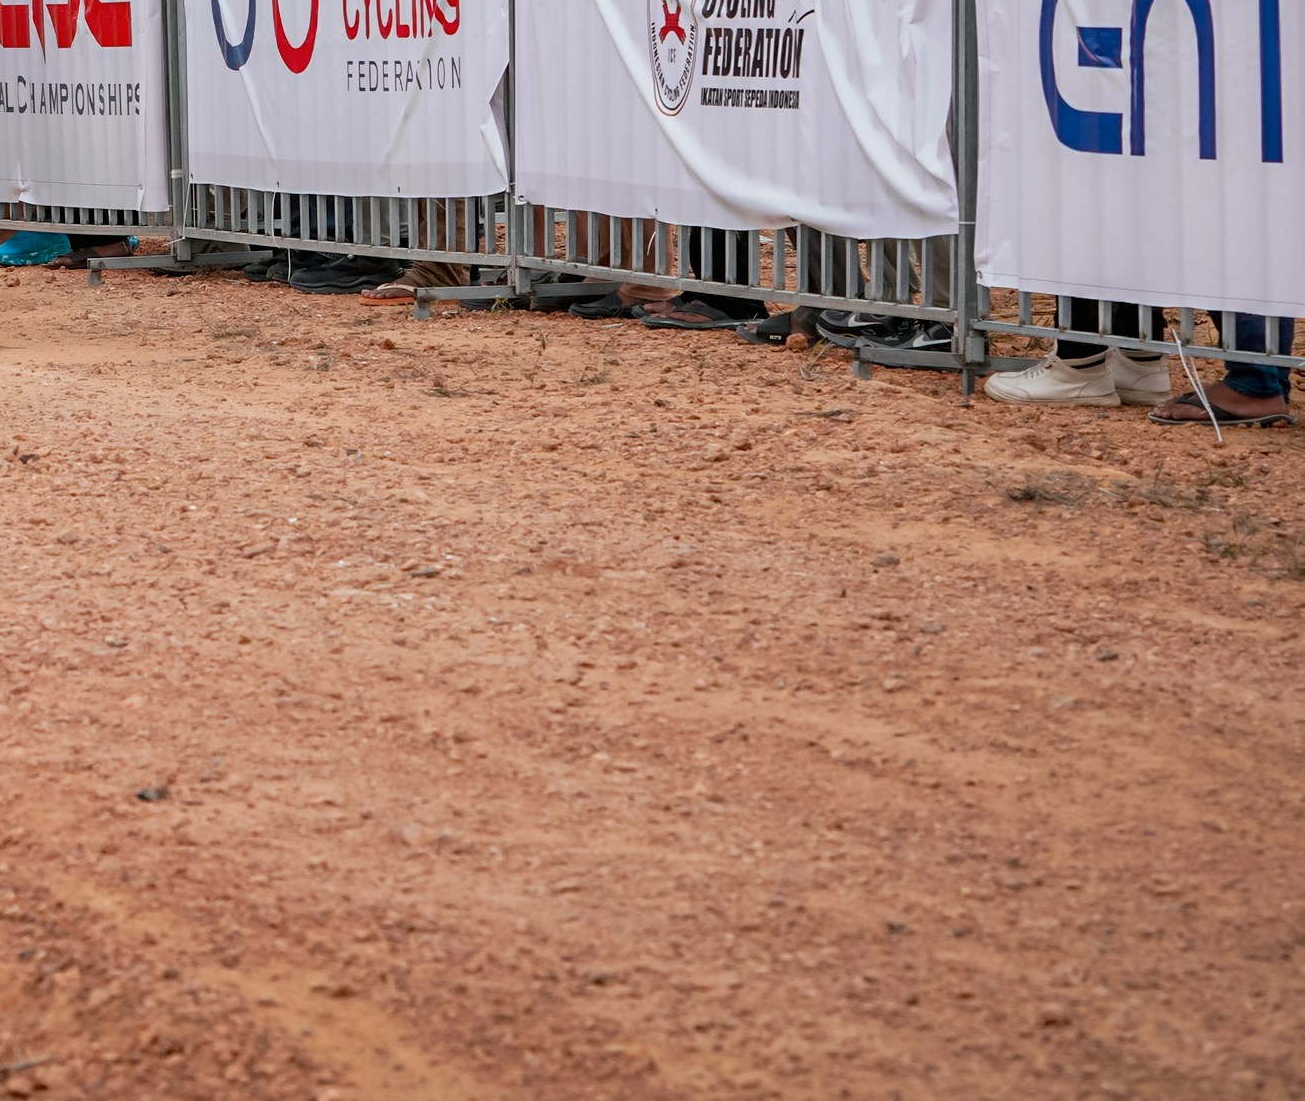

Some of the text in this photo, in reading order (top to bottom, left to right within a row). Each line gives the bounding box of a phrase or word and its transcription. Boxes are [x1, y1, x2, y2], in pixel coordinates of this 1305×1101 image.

[702, 27, 805, 79] FEDERATION
[700, 87, 800, 110] IKATAN SPORT SEPEDA INDONESIA
